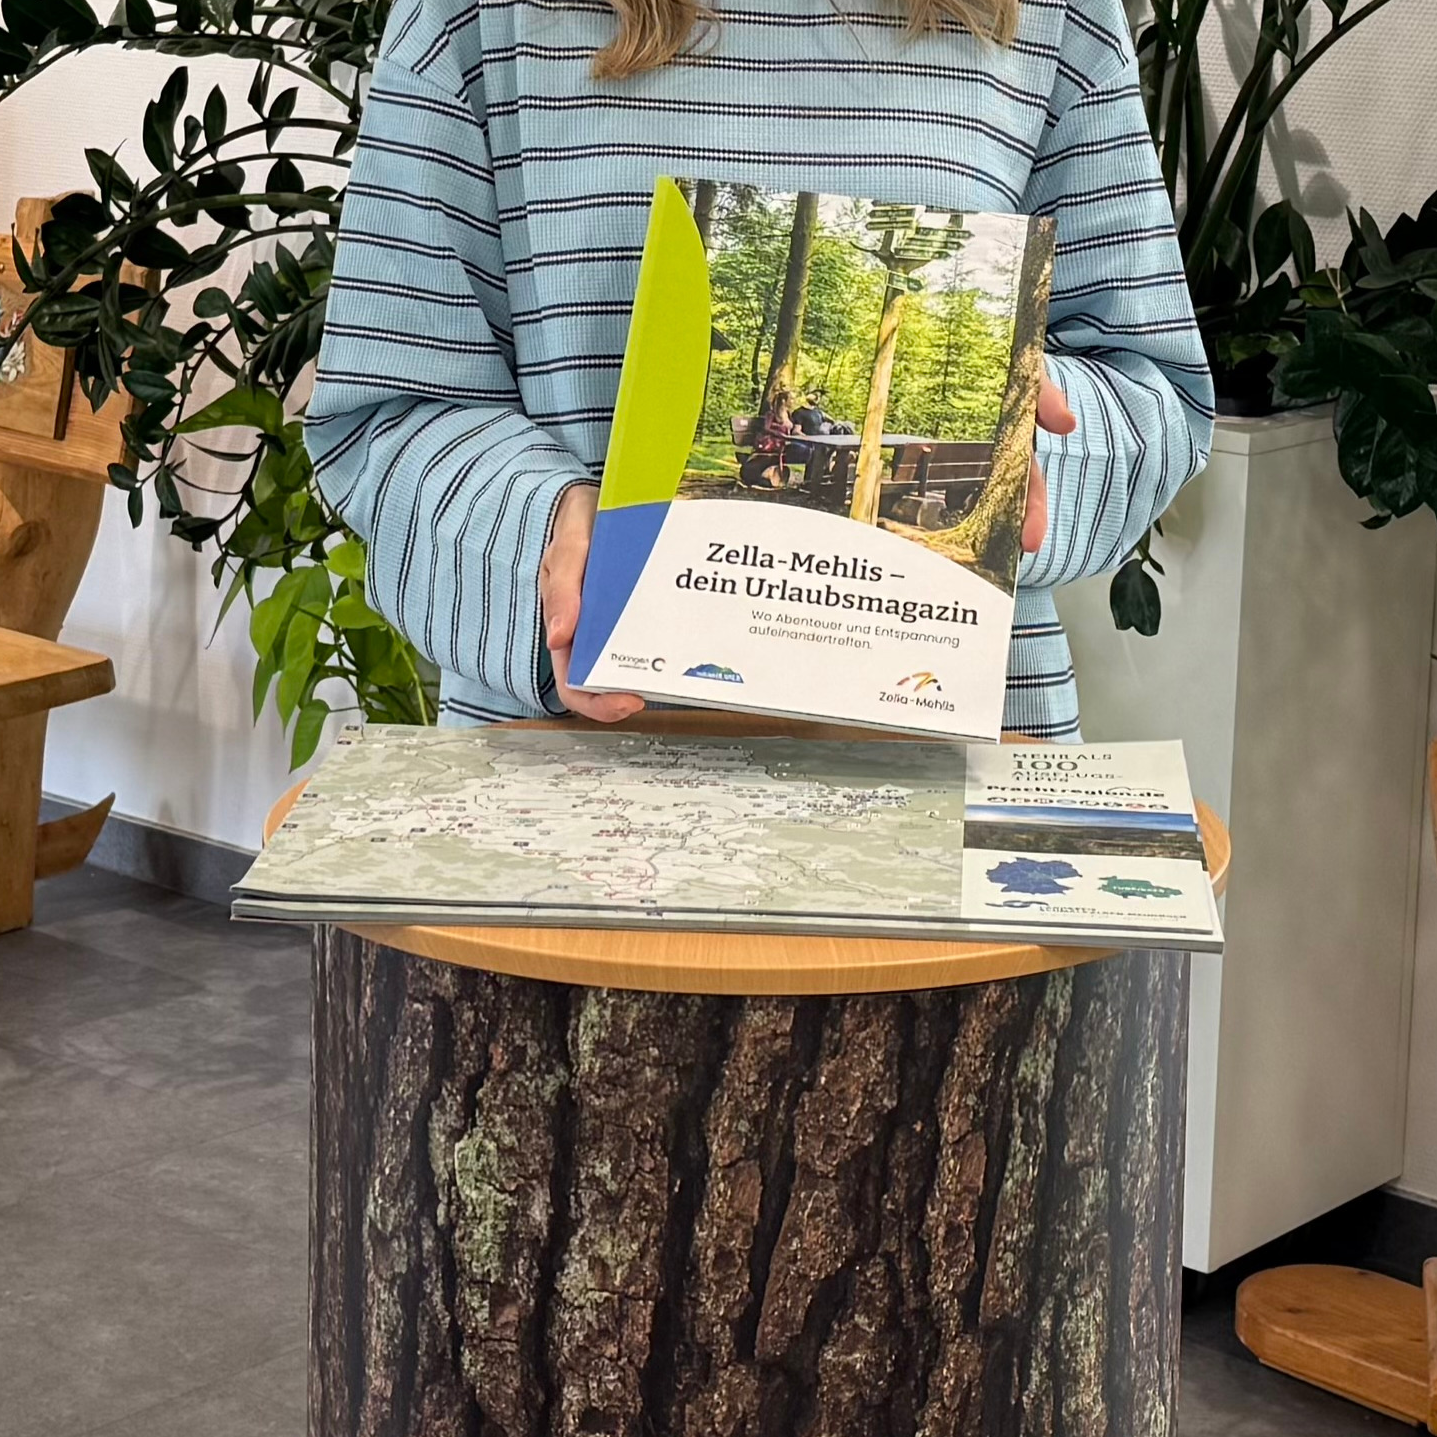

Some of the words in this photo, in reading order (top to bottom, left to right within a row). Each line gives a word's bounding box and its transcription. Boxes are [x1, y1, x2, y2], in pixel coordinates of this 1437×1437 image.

[705, 542, 883, 582] Zella-Mehlis
[675, 568, 737, 595] dein
[745, 577, 979, 625] Urlaubsmagazin
[751, 610, 772, 622] Wo
[847, 623, 871, 635] und
[875, 626, 960, 648] Entspannung
[1013, 760, 1078, 772] 100
